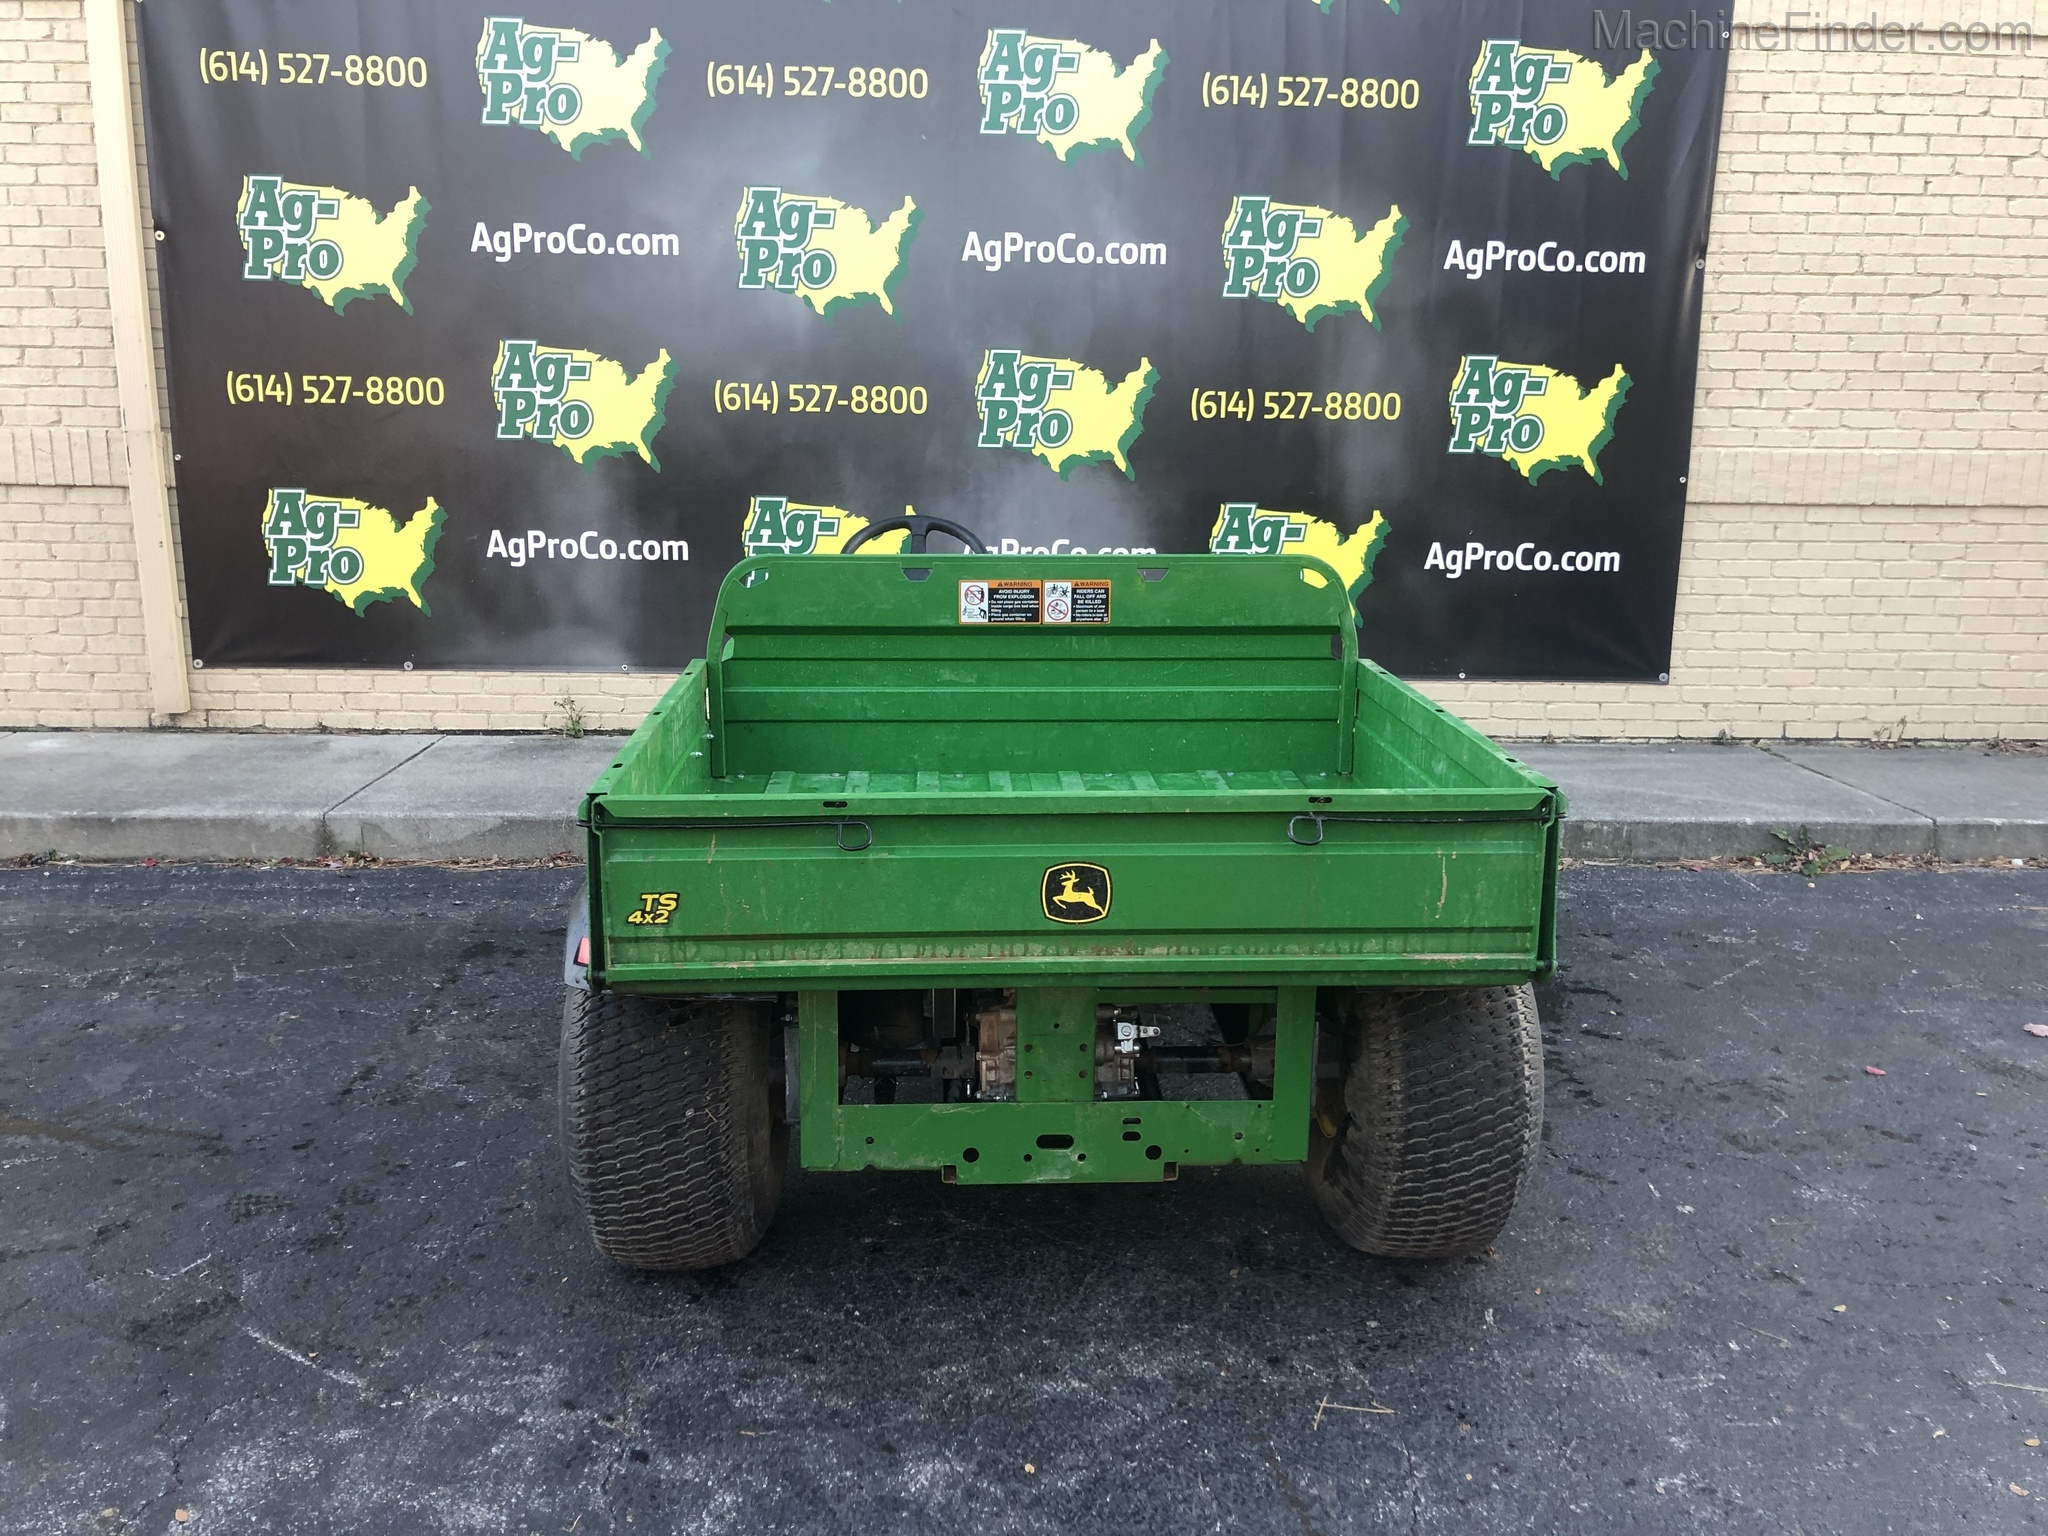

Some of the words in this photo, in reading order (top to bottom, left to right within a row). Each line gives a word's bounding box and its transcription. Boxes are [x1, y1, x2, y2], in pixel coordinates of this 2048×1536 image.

[200, 48, 268, 86] (614)
[277, 52, 428, 88] 527-8800
[479, 17, 579, 84] Ag-
[980, 29, 1080, 95] Ag-
[1471, 40, 1571, 105] Ag-
[482, 70, 582, 125] Pro
[707, 62, 774, 98] (614)
[783, 65, 929, 99] 527-8800
[1202, 72, 1268, 109] (614)
[1277, 76, 1420, 109] 527-8800
[980, 81, 1079, 135] Pro
[1468, 92, 1567, 145] Pro
[240, 176, 339, 241] Ag-
[737, 187, 836, 250] Ag-
[1224, 197, 1322, 259] Ag-
[244, 227, 343, 280] Pro
[470, 222, 680, 263] AgProCo.com
[738, 237, 836, 289] Pro
[961, 230, 1167, 271] AgProCo.com
[1443, 239, 1646, 279] AgProCo.com
[1222, 246, 1320, 298] Pro
[226, 370, 293, 406] (614)
[302, 375, 445, 405] 527-8800
[495, 340, 590, 399] Ag-
[979, 349, 1073, 409] Ag-
[1452, 356, 1547, 413] Ag-
[496, 389, 593, 438] Pro
[714, 379, 779, 415] (614)
[788, 383, 928, 415] 527-8800
[1191, 387, 1255, 422] (614)
[1263, 391, 1401, 421] 527-8800
[976, 398, 1072, 448] Pro
[1449, 404, 1543, 453] Pro
[265, 489, 360, 546] Ag-
[268, 537, 363, 584] Pro
[486, 529, 689, 568] AgProCo.com
[1423, 541, 1620, 579] AgProCo.com
[626, 909, 670, 925] 4x2
[640, 892, 679, 912] TS
